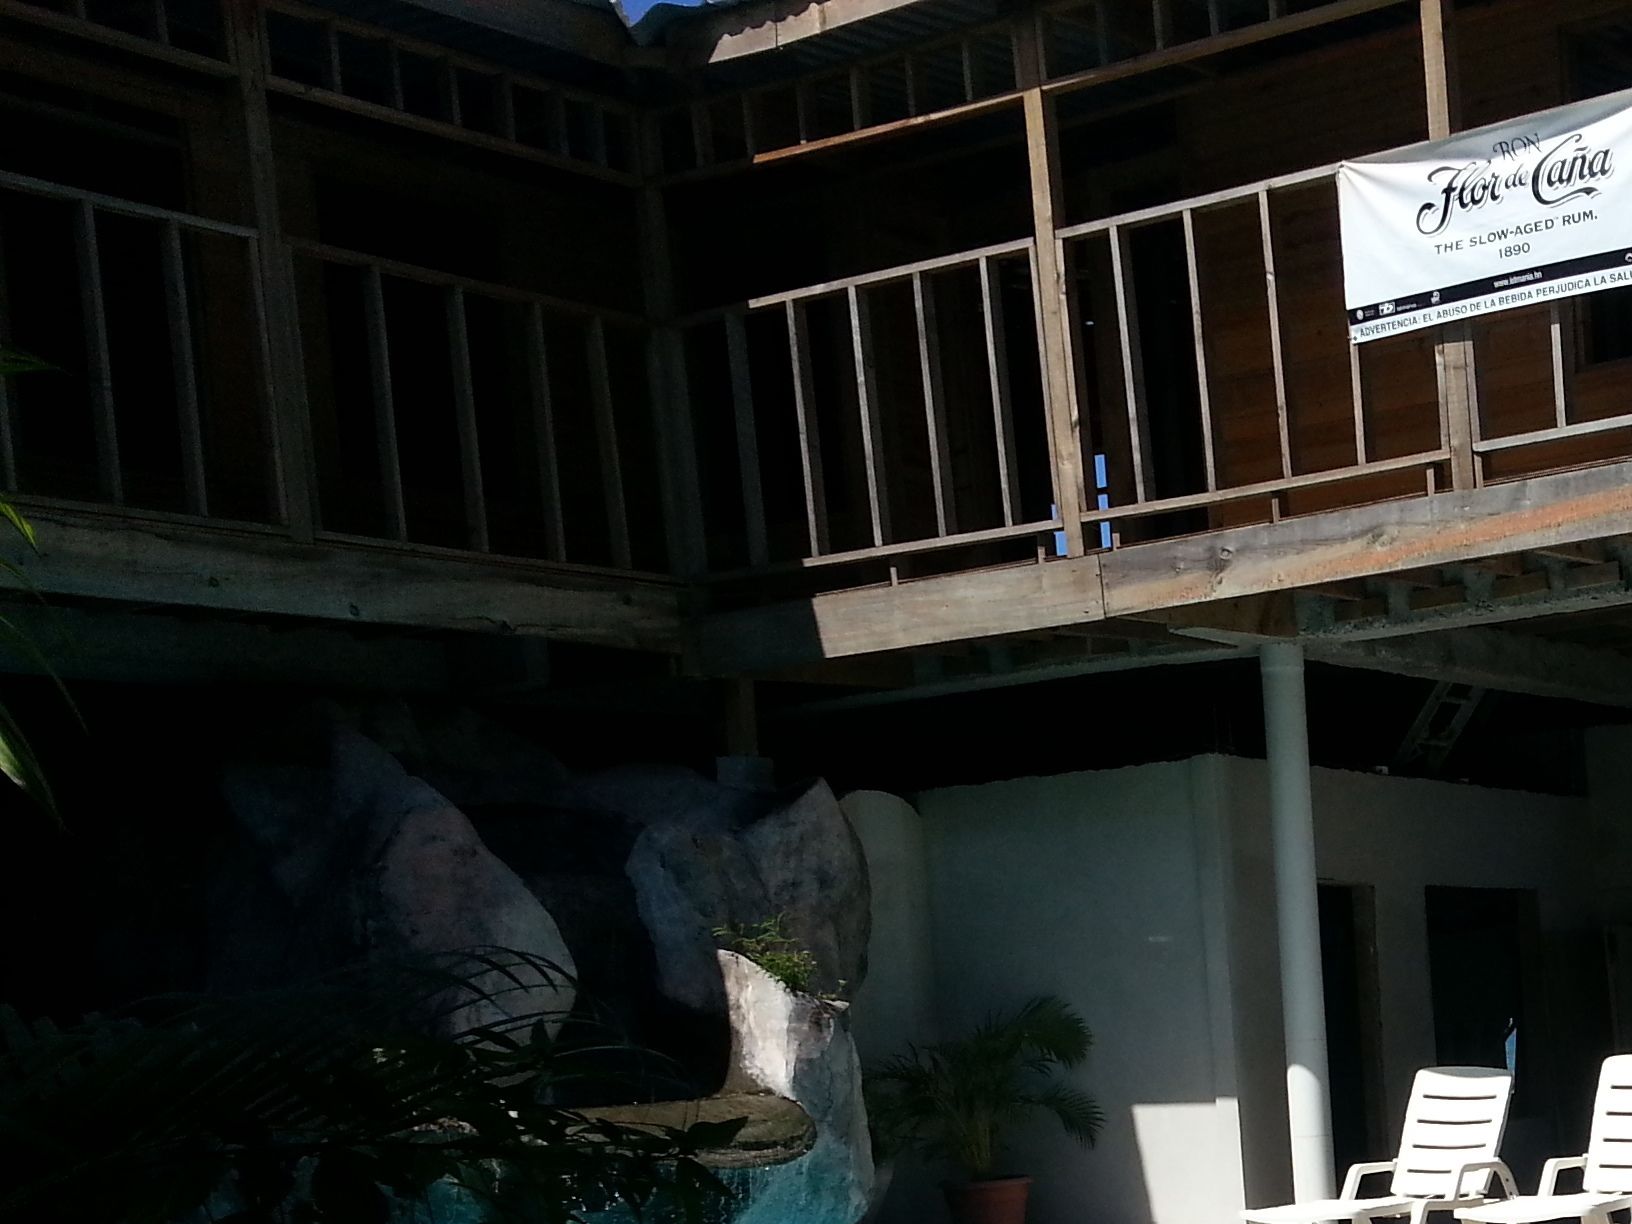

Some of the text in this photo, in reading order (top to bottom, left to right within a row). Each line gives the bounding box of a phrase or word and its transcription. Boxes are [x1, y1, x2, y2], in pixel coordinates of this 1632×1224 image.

[1493, 132, 1542, 161] RON
[1416, 133, 1615, 236] Flor de Caña
[1434, 240, 1464, 255] THE
[1562, 210, 1598, 227] RUM.
[1498, 242, 1531, 259] 1890
[1360, 316, 1420, 337] ADVERTENCIA:
[1423, 312, 1432, 323] EL
[1436, 305, 1468, 319] ABUSO
[1469, 301, 1481, 312] DE
[1484, 297, 1496, 309] LA
[1498, 290, 1534, 306] BEBIDA
[1536, 277, 1592, 298] PERJUDICA
[1593, 275, 1607, 286] LA
